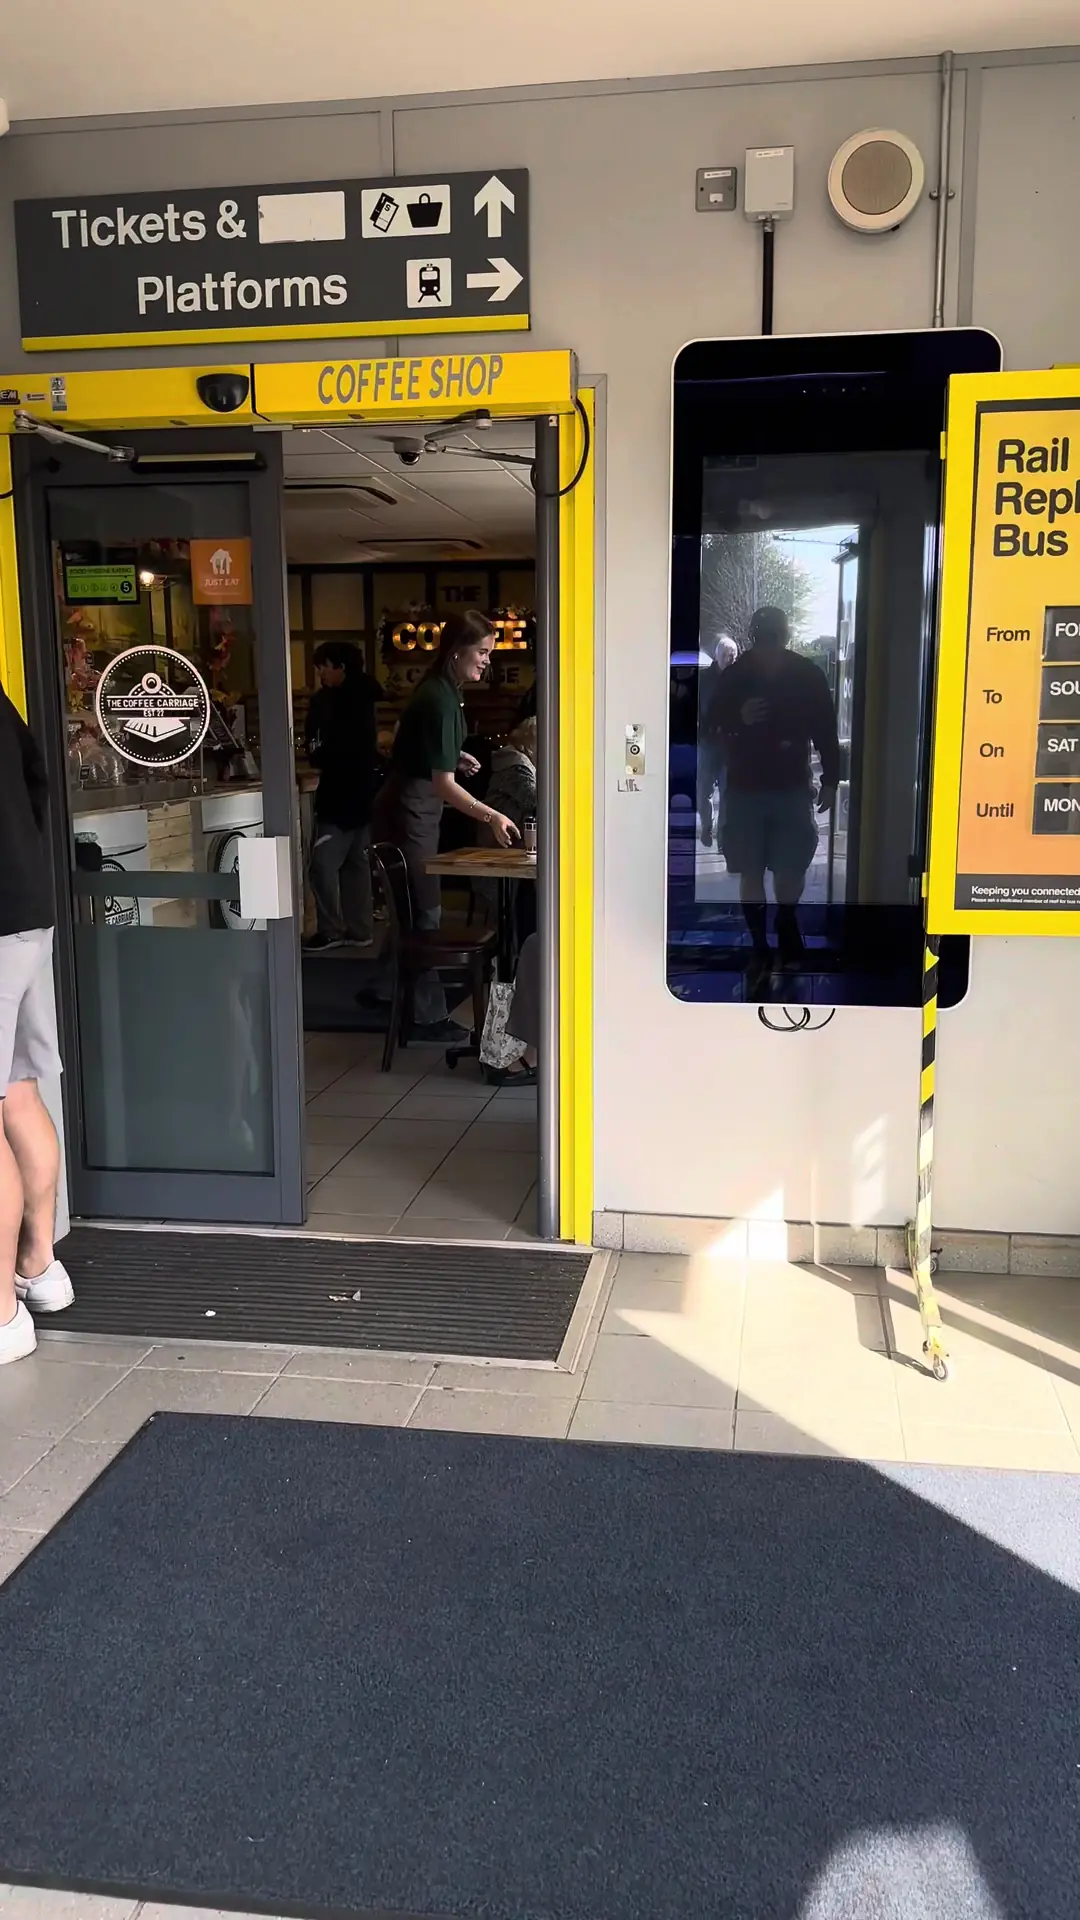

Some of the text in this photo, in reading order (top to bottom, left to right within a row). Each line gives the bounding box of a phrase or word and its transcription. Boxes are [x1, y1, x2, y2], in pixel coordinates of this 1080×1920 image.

[52, 199, 248, 248] Tickets &
[137, 271, 348, 315] Platforms
[318, 354, 504, 405] COFFEE SHOP
[997, 436, 1070, 474] Rail
[994, 479, 1080, 524] Repl
[993, 524, 1069, 557] Bus
[123, 582, 130, 592] 5
[204, 578, 240, 587] JUST EAT
[986, 626, 1031, 642] From
[1055, 622, 1080, 637] FO
[107, 698, 199, 708] THE COFFEE CARRIAGE
[982, 689, 1003, 704] To
[143, 709, 165, 717] EST 22
[979, 742, 1005, 758] On
[1047, 737, 1079, 752] SAT
[976, 803, 1014, 818] Until
[1043, 798, 1080, 813] MON
[971, 885, 1080, 897] Keeping you connected
